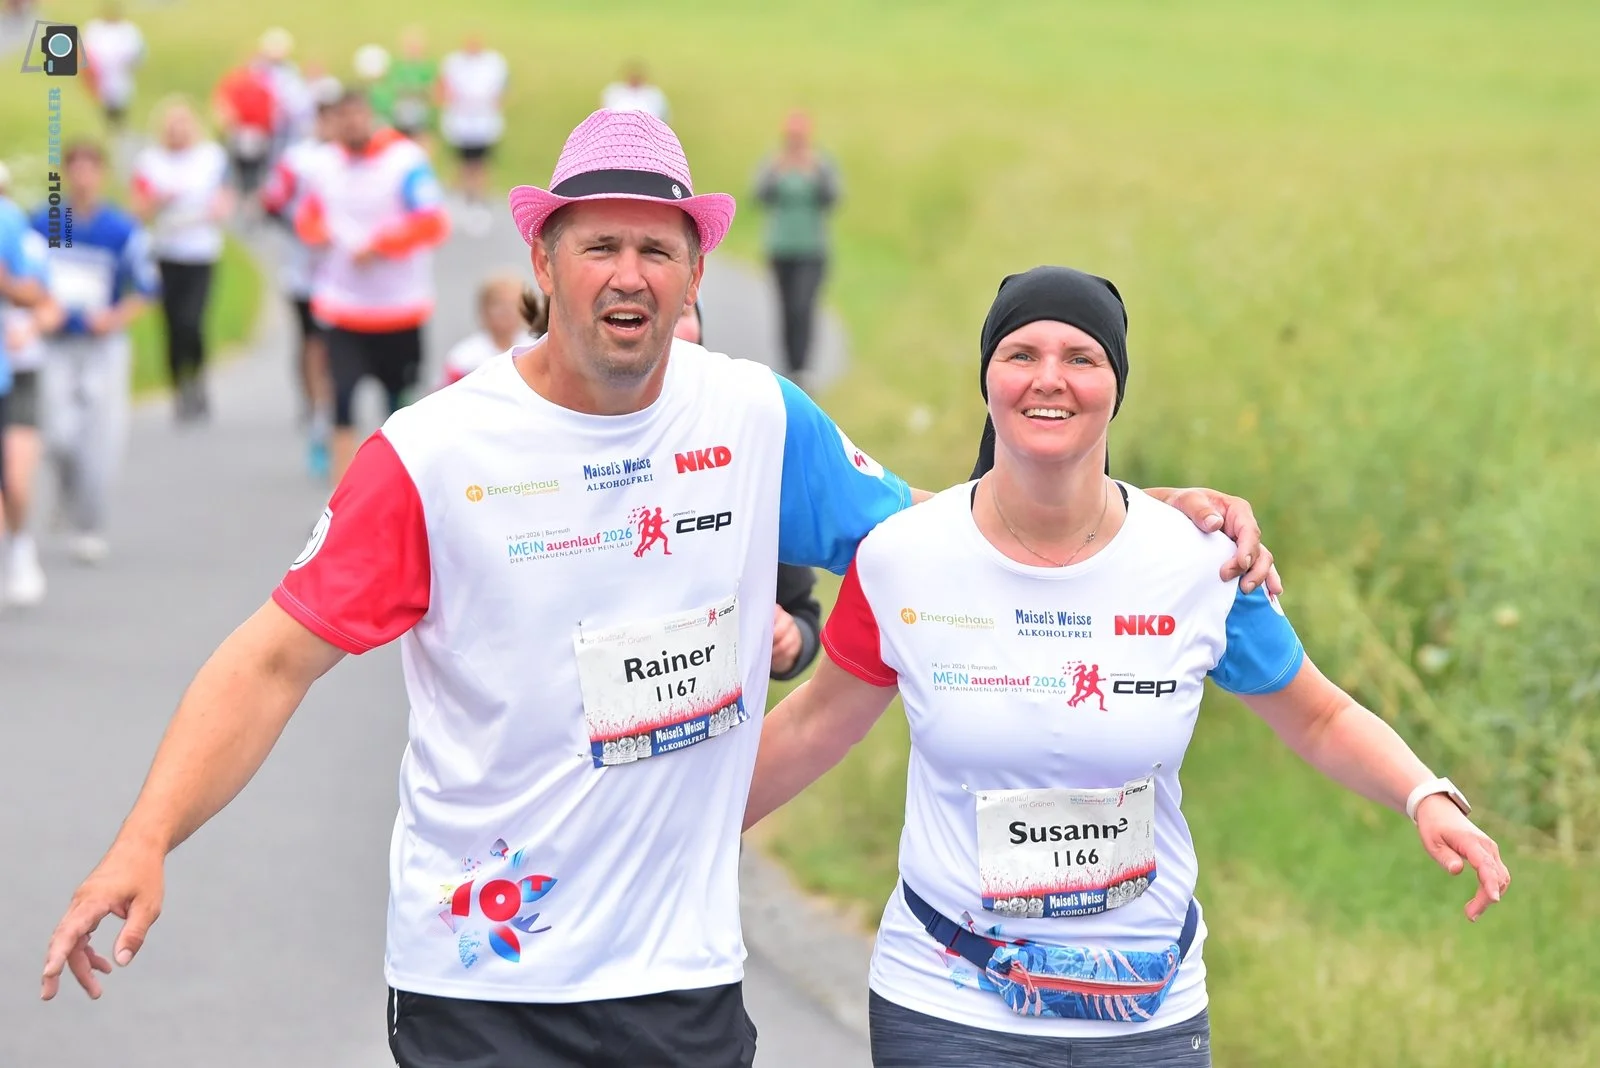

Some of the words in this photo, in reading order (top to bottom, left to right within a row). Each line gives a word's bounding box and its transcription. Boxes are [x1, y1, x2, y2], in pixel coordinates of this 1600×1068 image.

[583, 460, 621, 480] Maisel's
[623, 457, 651, 475] Weisse
[674, 445, 732, 474] NKD
[487, 479, 559, 496] Energiehaus
[586, 474, 654, 492] ALKOHOLFREI
[675, 511, 732, 534] cep
[545, 527, 571, 537] Bayreuth
[508, 540, 544, 557] MEIN
[546, 532, 601, 552] auenlauf
[602, 527, 633, 543] 2026
[510, 556, 524, 564] DER
[920, 611, 994, 625] Energiehaus
[1015, 609, 1054, 626] Maisel's
[1057, 611, 1092, 627] Weisse
[1114, 614, 1176, 636] NKD
[1017, 628, 1093, 639] ALKOHOLFREI
[623, 644, 716, 682] Rainer
[933, 671, 969, 685] MEIN
[971, 675, 1031, 686] auenlauf
[1032, 675, 1066, 688] 2026
[1113, 679, 1177, 697] cep
[656, 677, 697, 702] 1167
[655, 726, 683, 744] Maisel's
[684, 720, 706, 736] Weisse
[658, 733, 706, 753] ALKOHOLFREI
[1125, 784, 1148, 796] cep
[1009, 817, 1129, 845] Susanne
[1054, 848, 1099, 867] 1166
[1049, 893, 1078, 909] Maisel's
[1051, 905, 1104, 917] ALKOHOLFREI
